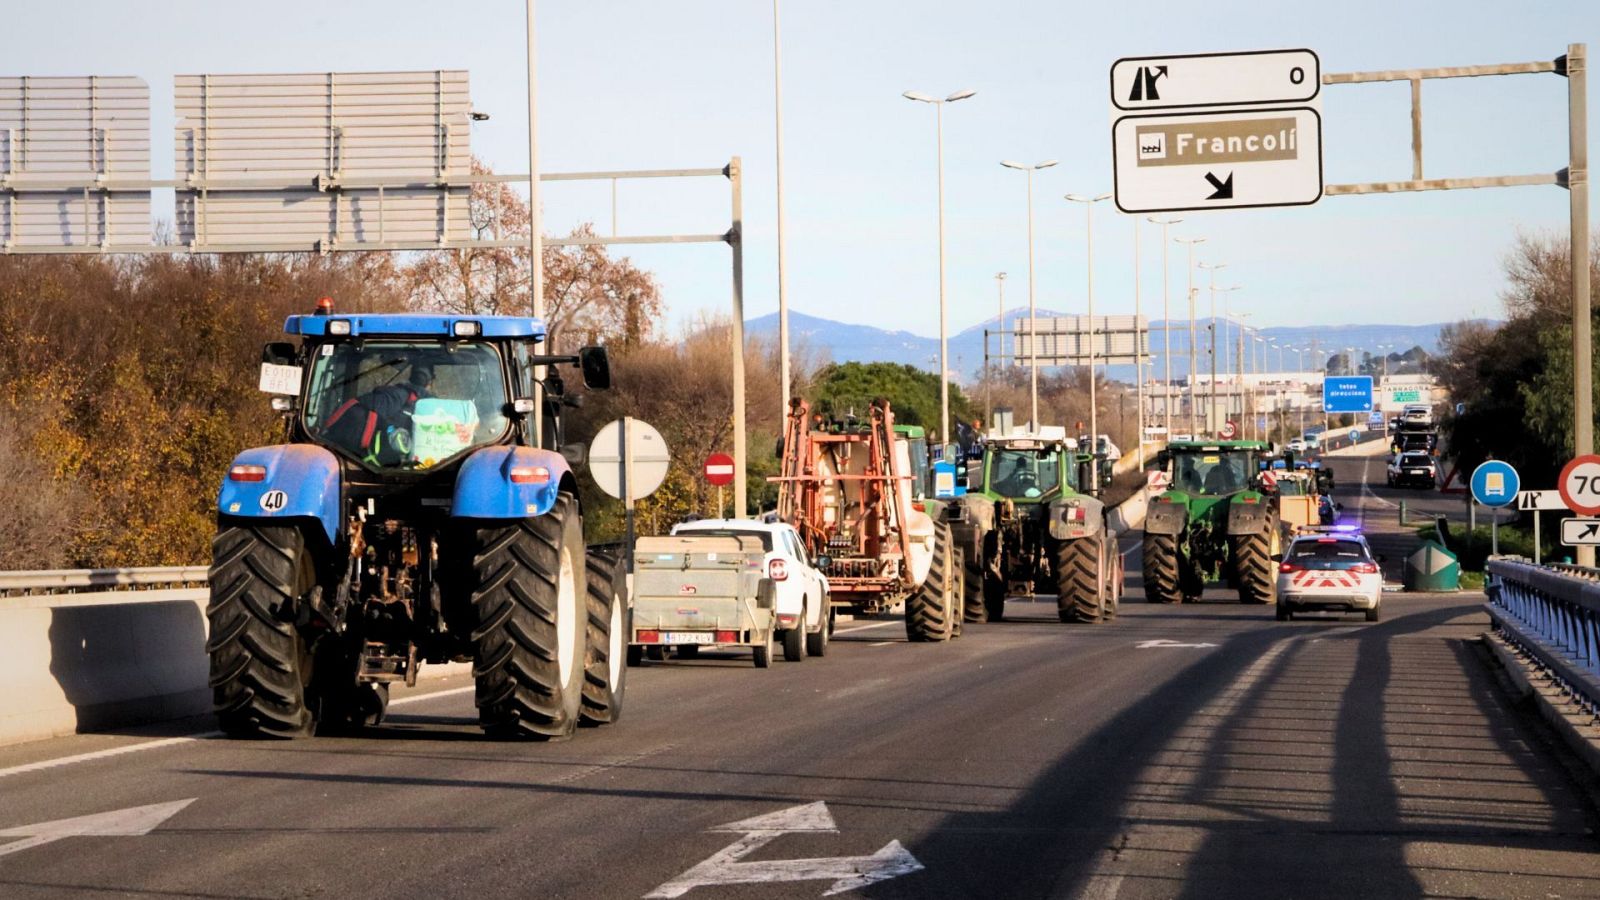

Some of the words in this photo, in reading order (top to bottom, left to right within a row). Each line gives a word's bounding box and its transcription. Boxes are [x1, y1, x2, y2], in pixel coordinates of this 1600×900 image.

[1289, 66, 1305, 85] 0
[1176, 128, 1297, 156] Francolí
[264, 492, 284, 509] 40
